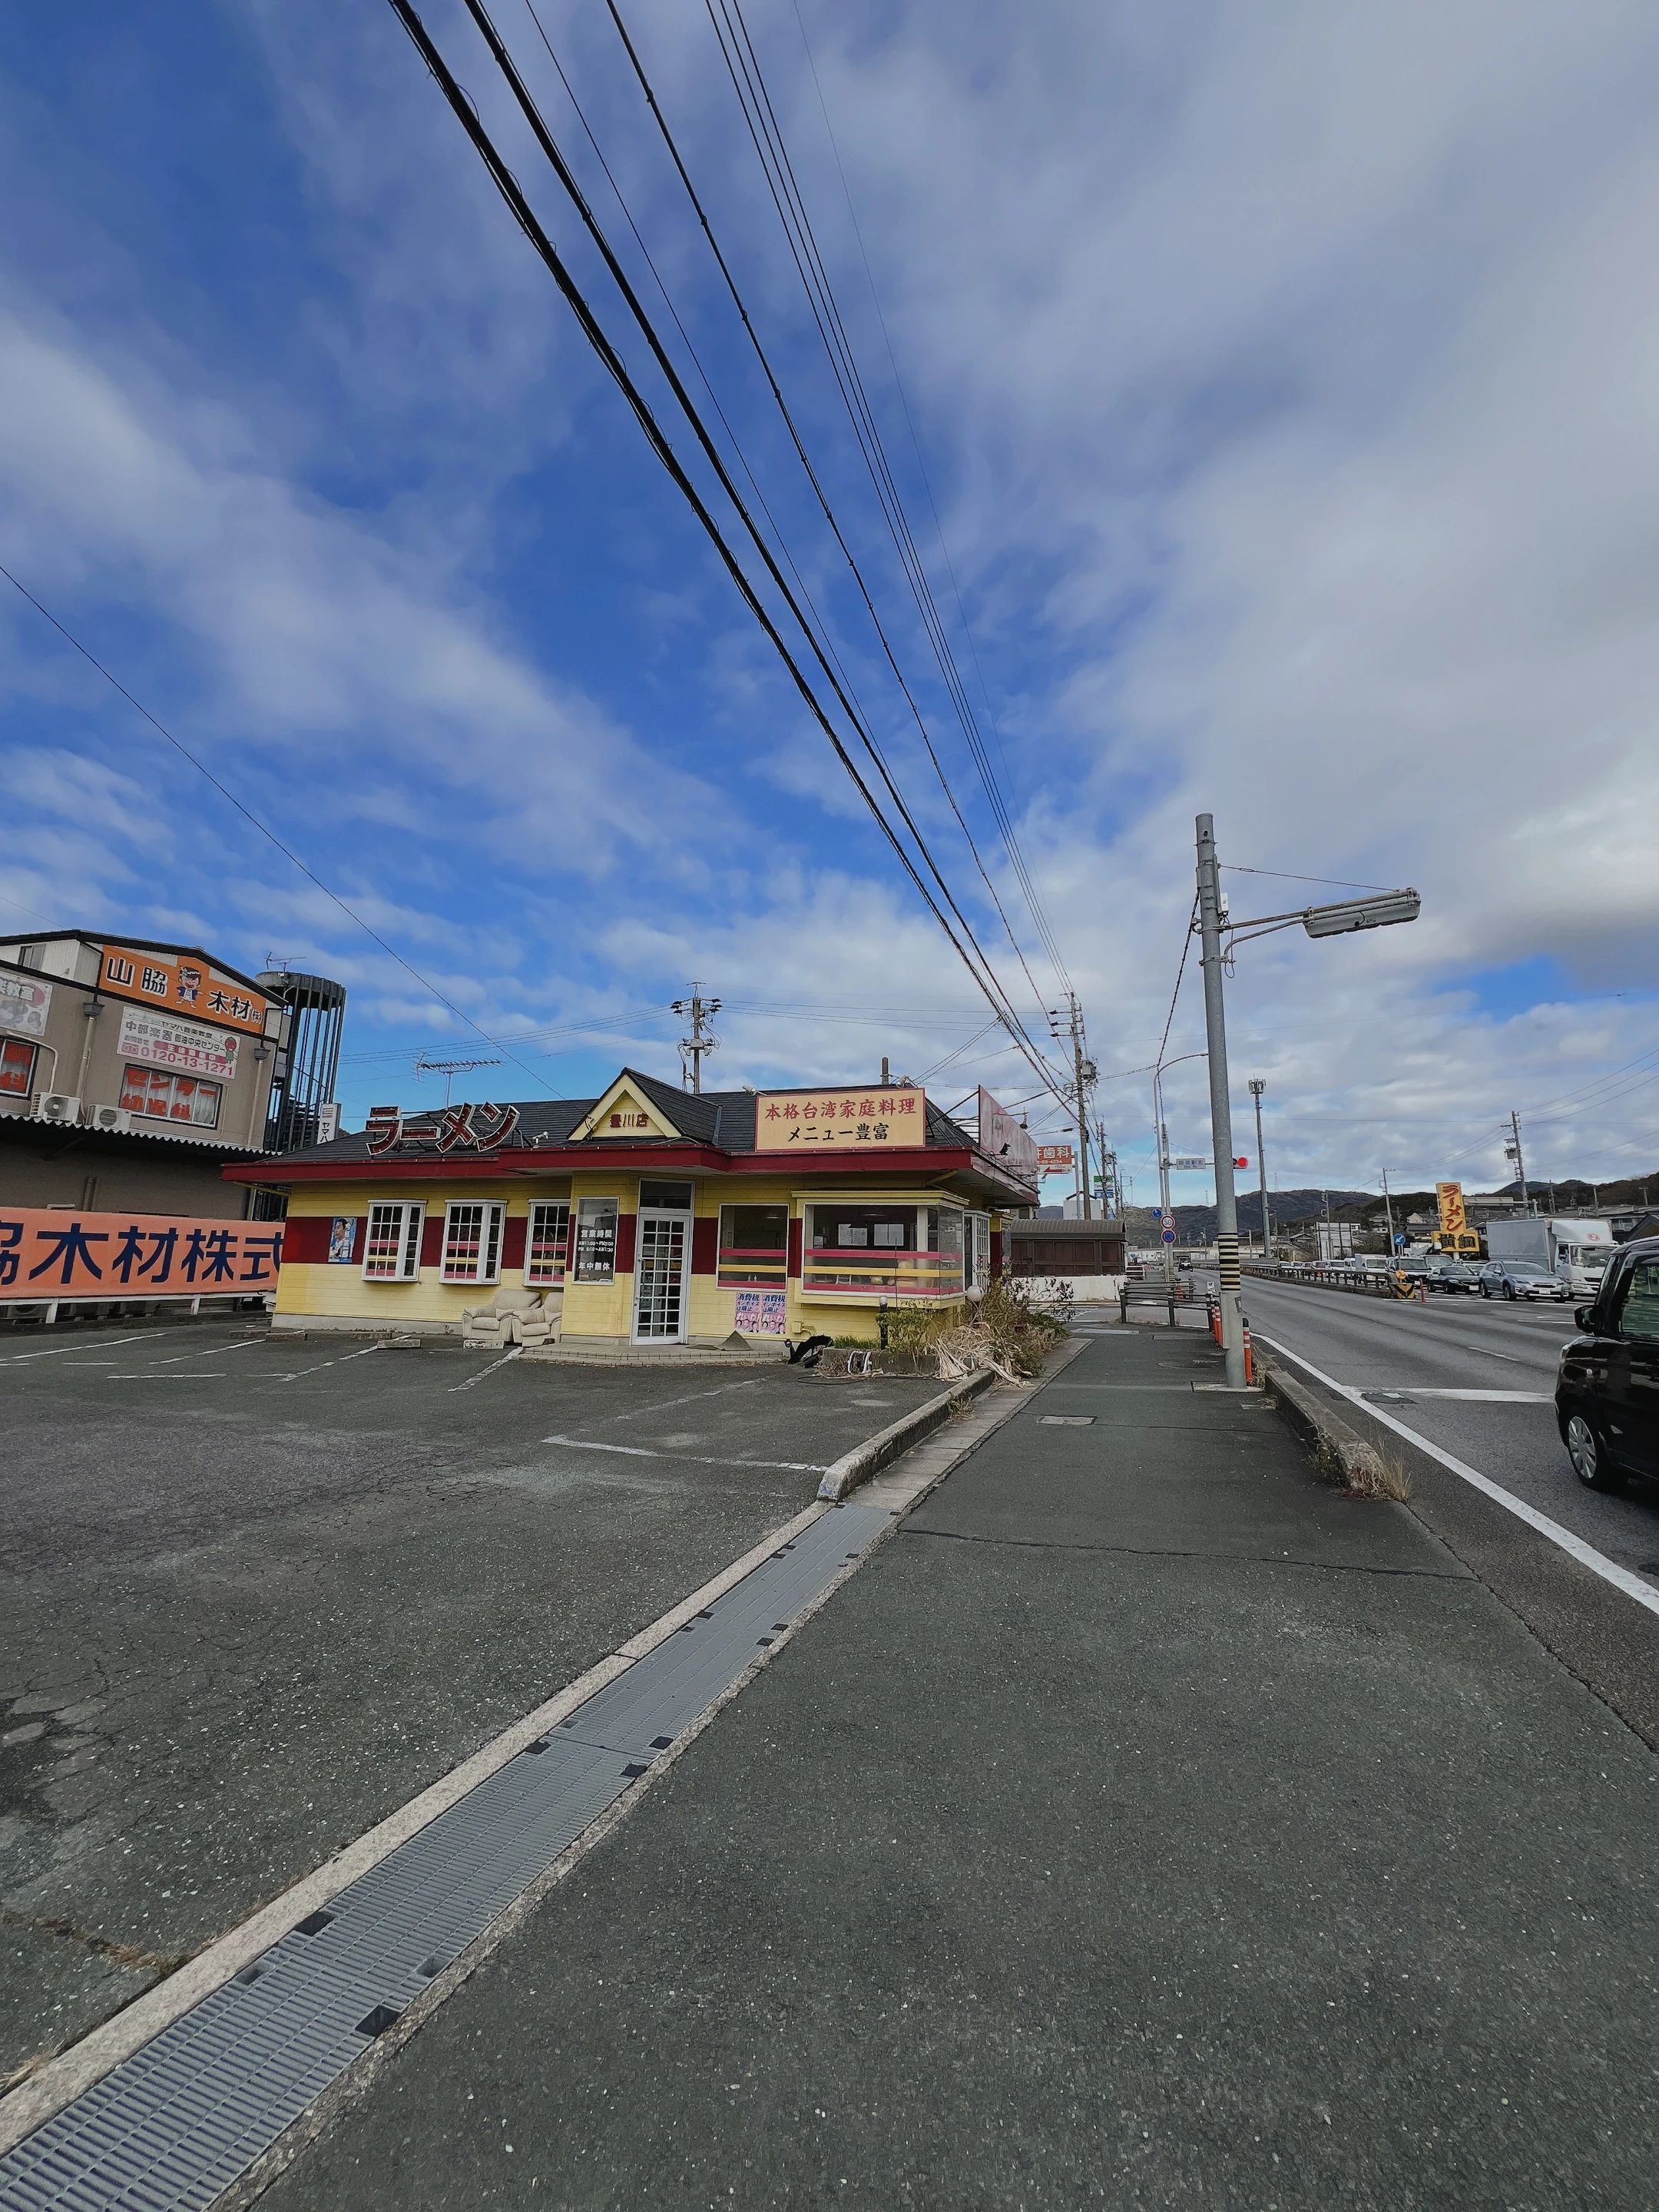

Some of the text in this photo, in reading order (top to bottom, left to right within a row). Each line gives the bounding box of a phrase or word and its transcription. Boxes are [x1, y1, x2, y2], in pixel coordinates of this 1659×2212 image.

[107, 958, 167, 997] 山脇
[141, 1047, 233, 1075] 0120-13-1271
[764, 1098, 916, 1121] 本格台湾家庭料理
[320, 1122, 330, 1142] ヤマハ
[365, 1102, 521, 1155] ラーメン
[788, 1122, 889, 1142] メニュー豊富
[1443, 1185, 1462, 1232] ラーメン
[578, 1262, 610, 1270] 年中無休
